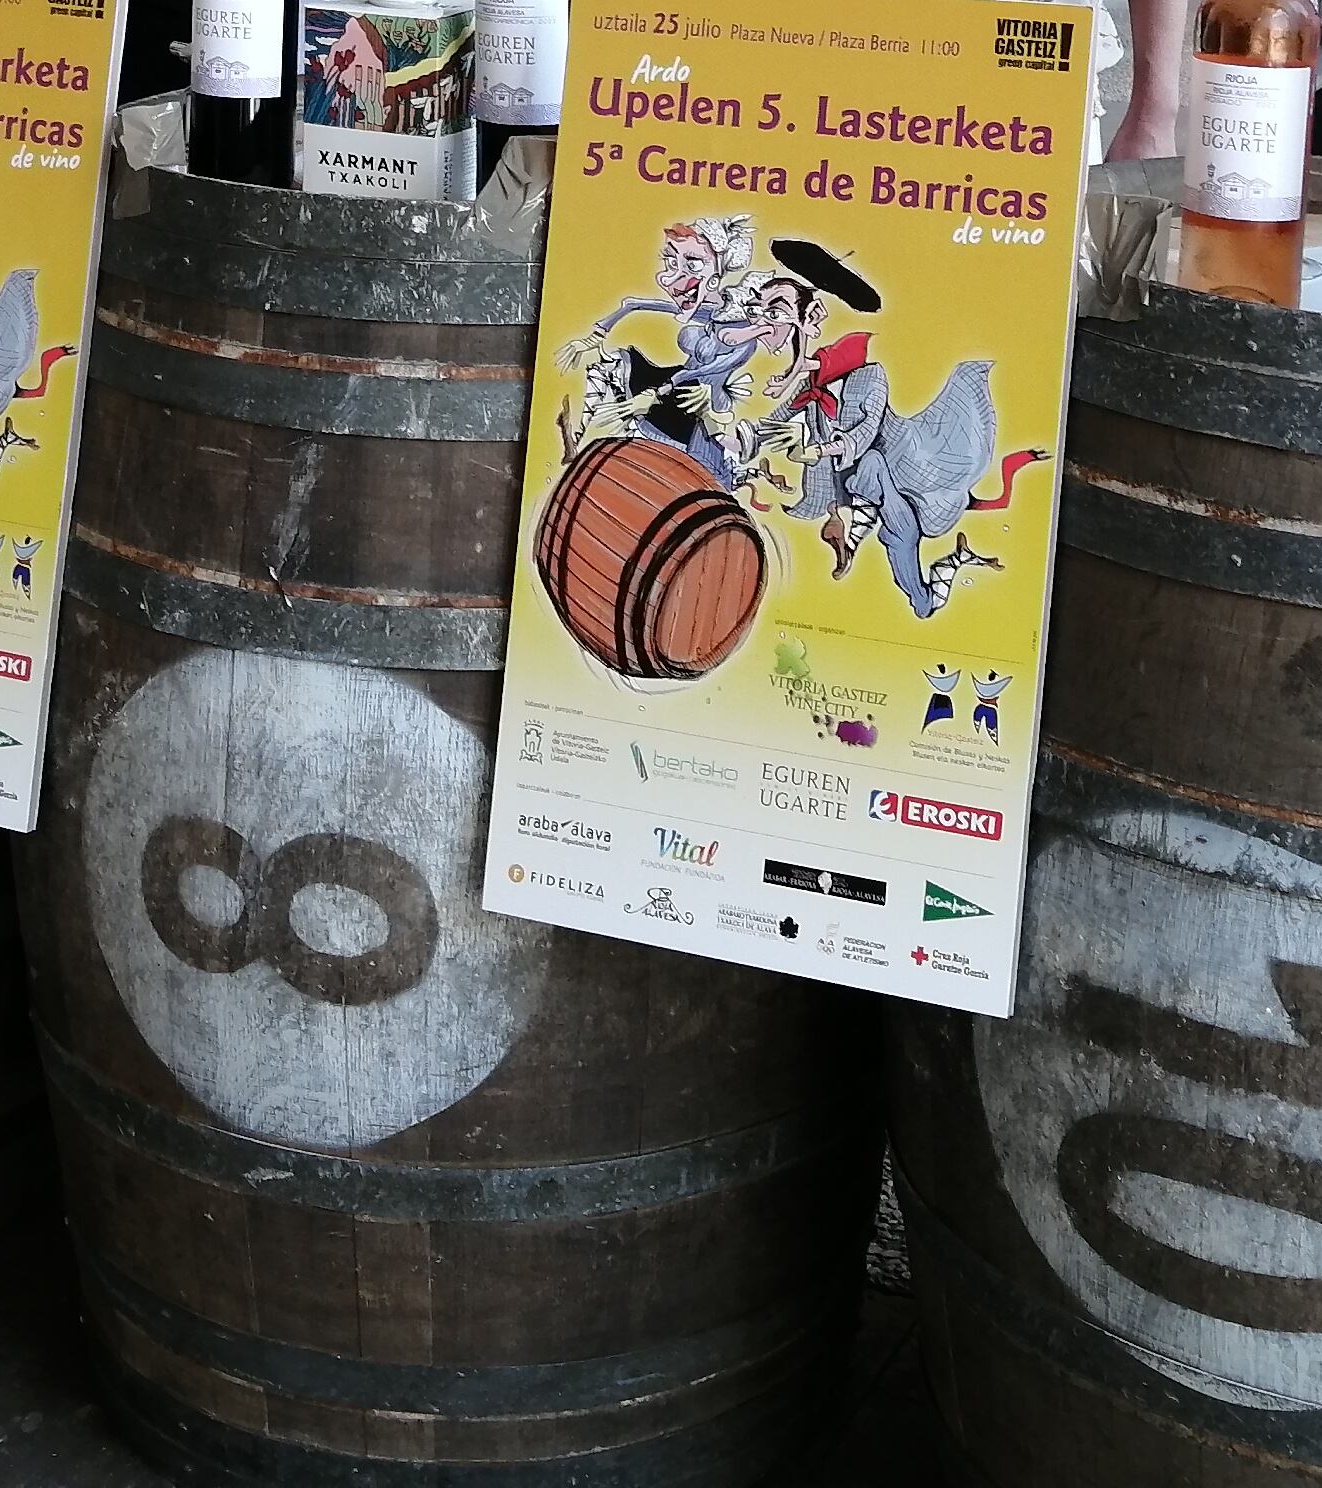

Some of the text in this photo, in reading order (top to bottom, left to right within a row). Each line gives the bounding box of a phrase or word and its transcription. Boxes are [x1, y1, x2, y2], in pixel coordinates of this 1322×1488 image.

[478, 32, 535, 50] EGUREN
[593, 14, 647, 33] uztaila
[653, 13, 679, 35] 25
[682, 18, 721, 40] julio
[730, 24, 765, 43] Plaza
[771, 27, 815, 46] Nueva
[829, 31, 865, 51] Plaza
[870, 35, 910, 53] Berria
[921, 40, 960, 57] 11:00
[997, 18, 1057, 40] VITORIA
[995, 37, 1057, 60] GASTEIZ
[630, 54, 692, 84] Ardo
[1225, 73, 1258, 85] RIOJA
[589, 76, 1054, 156] Upelen 5. Lasterketa
[1202, 114, 1278, 137] EGUREN
[10, 144, 81, 170] de vino
[1201, 132, 1276, 153] UGARTE
[318, 149, 418, 177] XARMANT
[328, 169, 408, 191] TXAKOLI
[583, 141, 1049, 221] 5ª Carrera de Barricas
[952, 216, 1045, 247] de vino
[769, 674, 889, 707] VITORIA GASTEIZ
[783, 694, 859, 719] WINE CITY
[653, 749, 739, 782] bertako
[762, 762, 851, 795] EGUREN
[759, 788, 848, 821] UGARTE
[907, 802, 997, 835] EROSKI
[518, 814, 612, 843] araba álava
[653, 826, 720, 867] Vital
[530, 870, 605, 898] FIDELIZA
[140, 814, 440, 1007] 8
